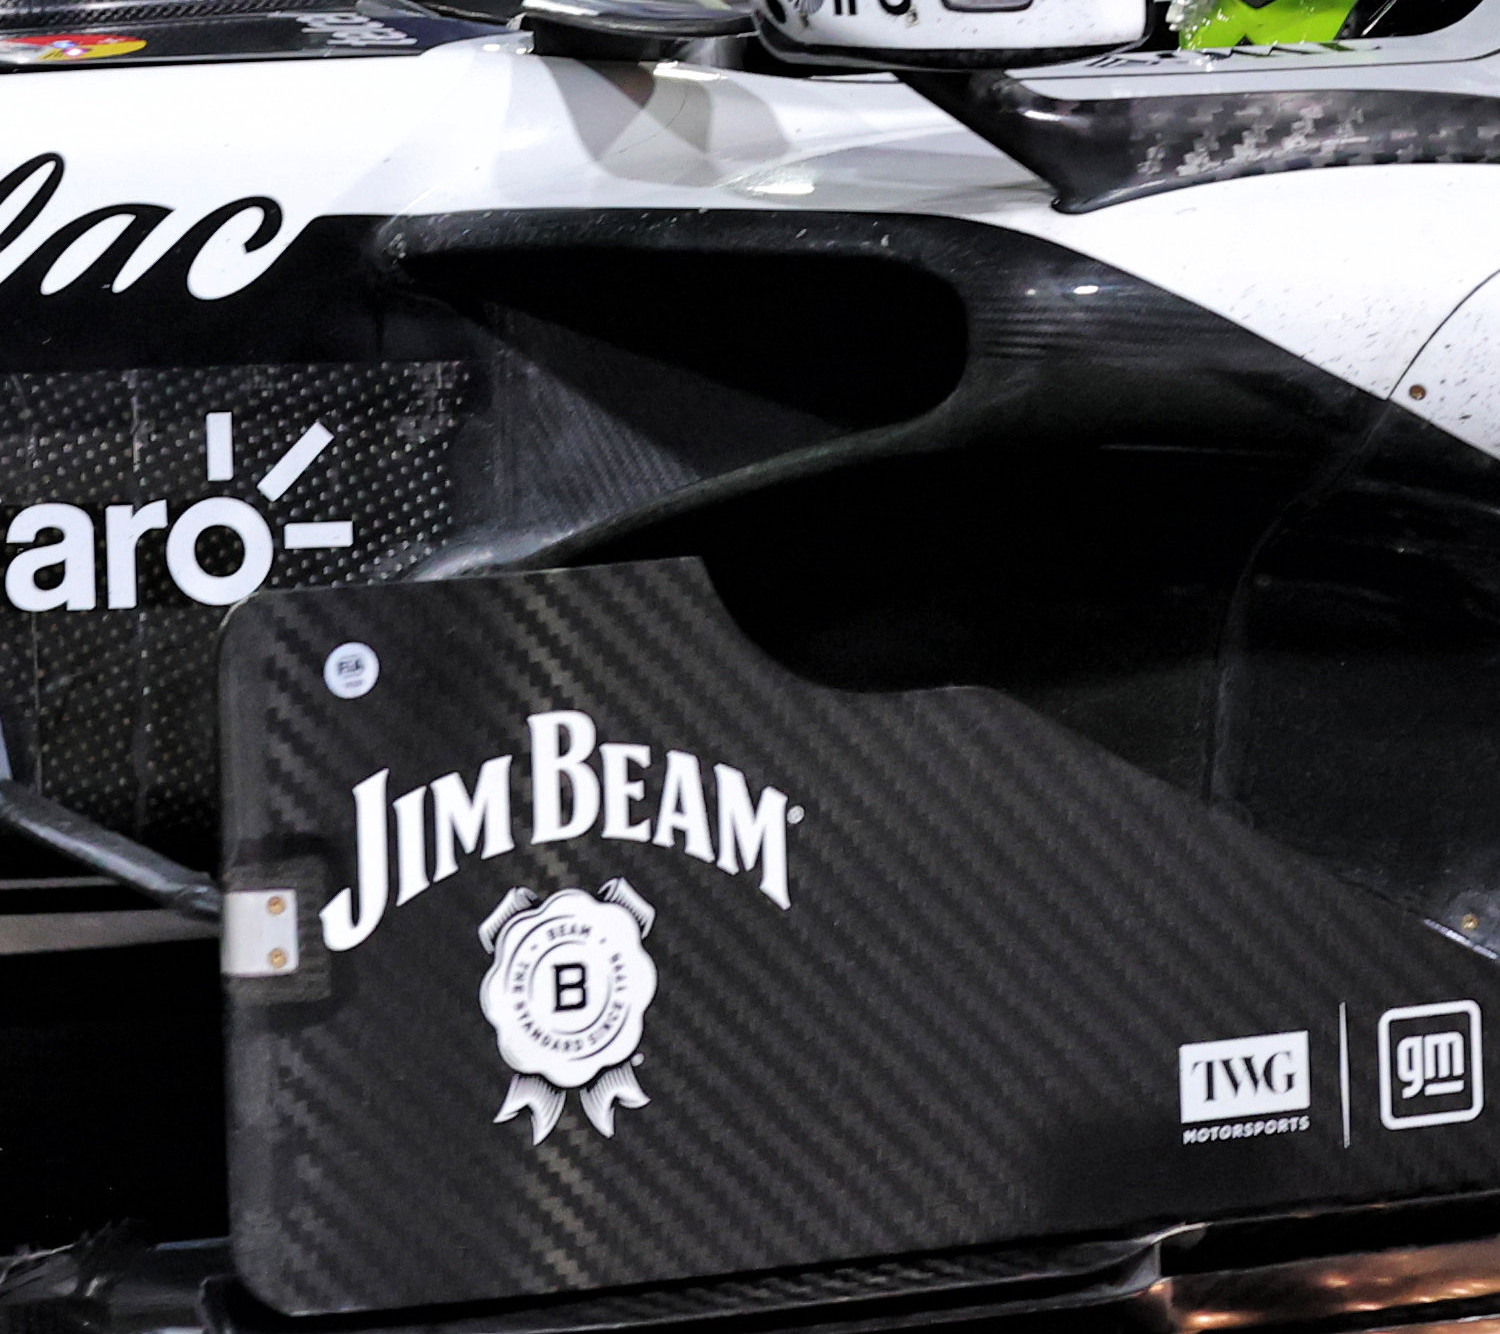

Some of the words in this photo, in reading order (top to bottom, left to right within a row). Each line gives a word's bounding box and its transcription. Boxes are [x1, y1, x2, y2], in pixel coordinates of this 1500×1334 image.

[318, 753, 515, 952] JIM
[526, 709, 791, 910] BEAM
[546, 922, 593, 941] BEAM
[553, 962, 587, 1013] B
[1191, 1050, 1298, 1103] TWG
[1396, 1030, 1465, 1100] gm
[1181, 1115, 1312, 1146] MOTORSPORTS
